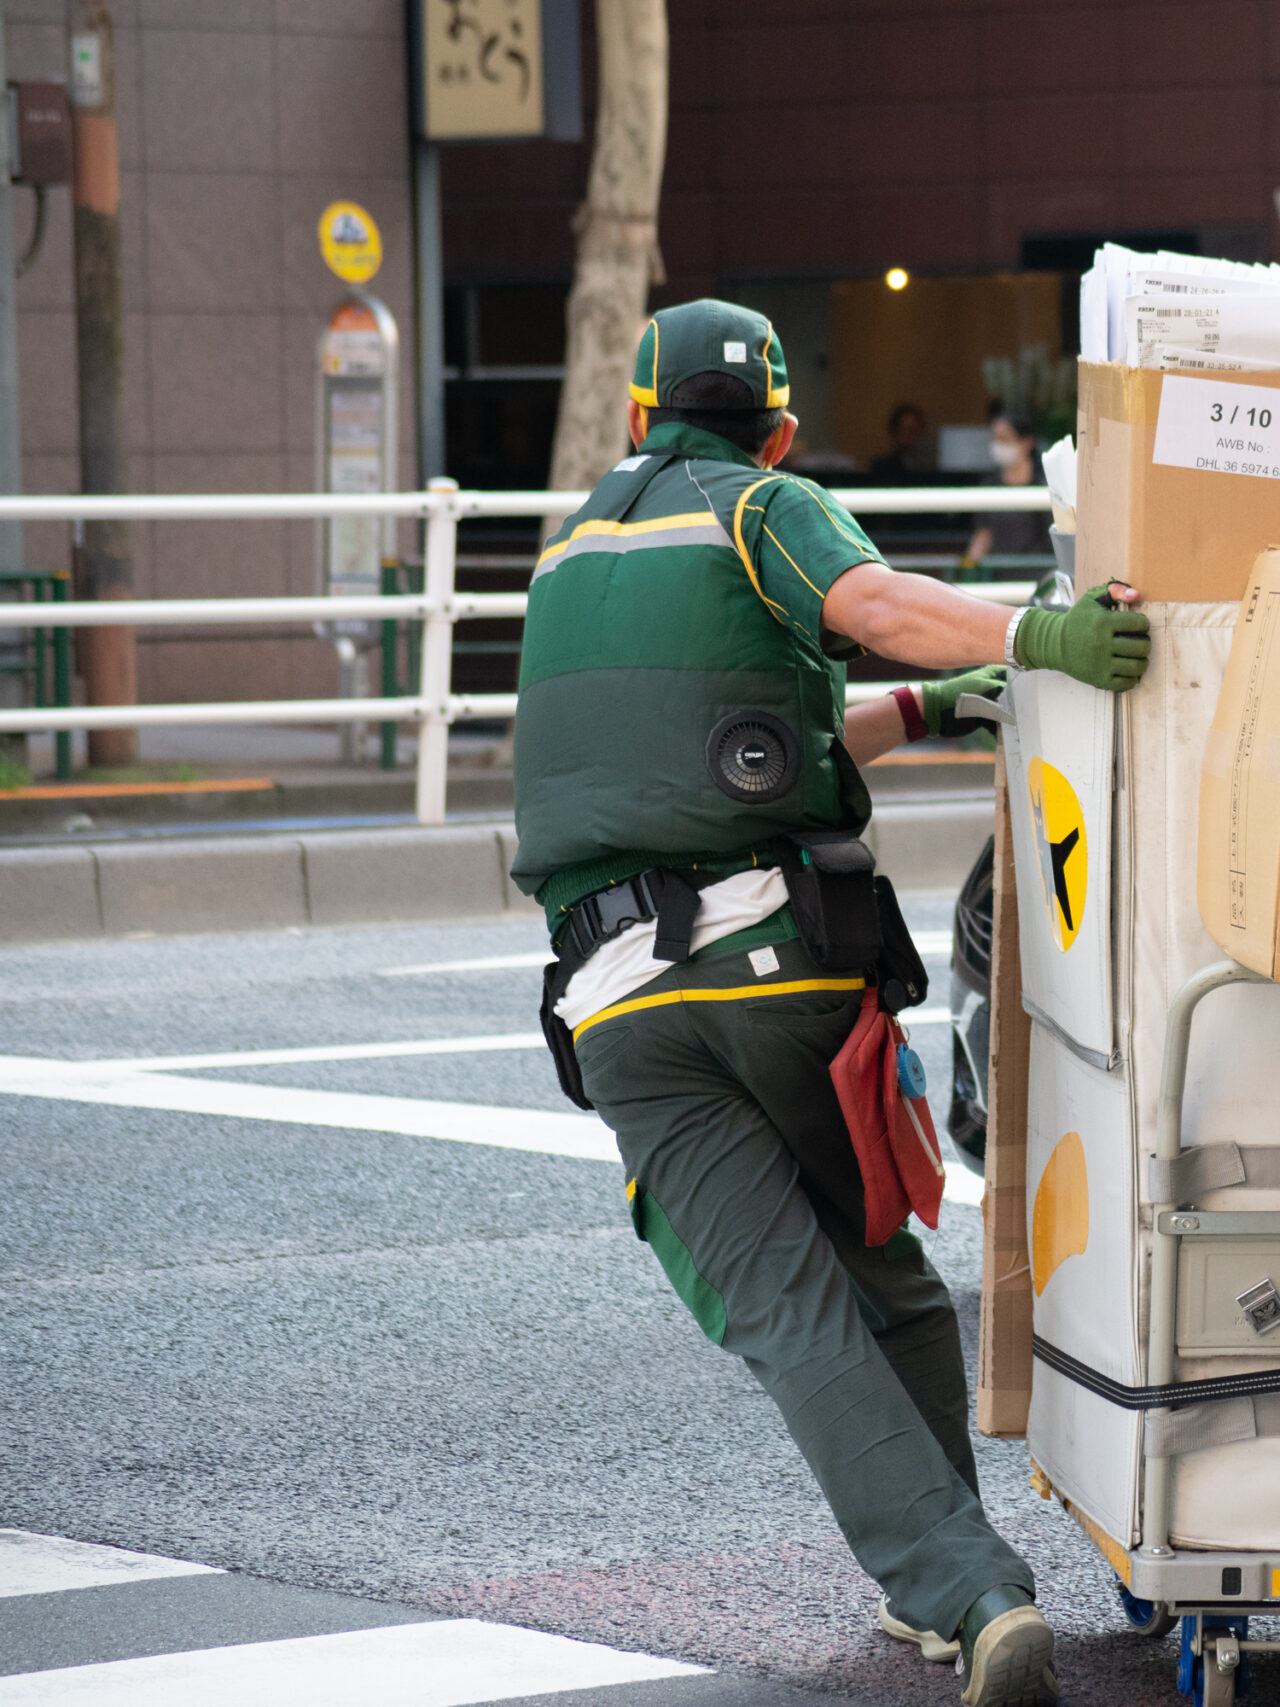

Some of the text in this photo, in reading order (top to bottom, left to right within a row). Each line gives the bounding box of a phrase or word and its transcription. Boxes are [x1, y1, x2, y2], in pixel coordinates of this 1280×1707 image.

[1210, 403, 1272, 428] 3 / 10
[1215, 437, 1244, 450] AWB
[1247, 441, 1264, 453] No
[1196, 457, 1220, 470] DHL
[1223, 460, 1238, 472] 36
[1241, 462, 1269, 476] 5974
